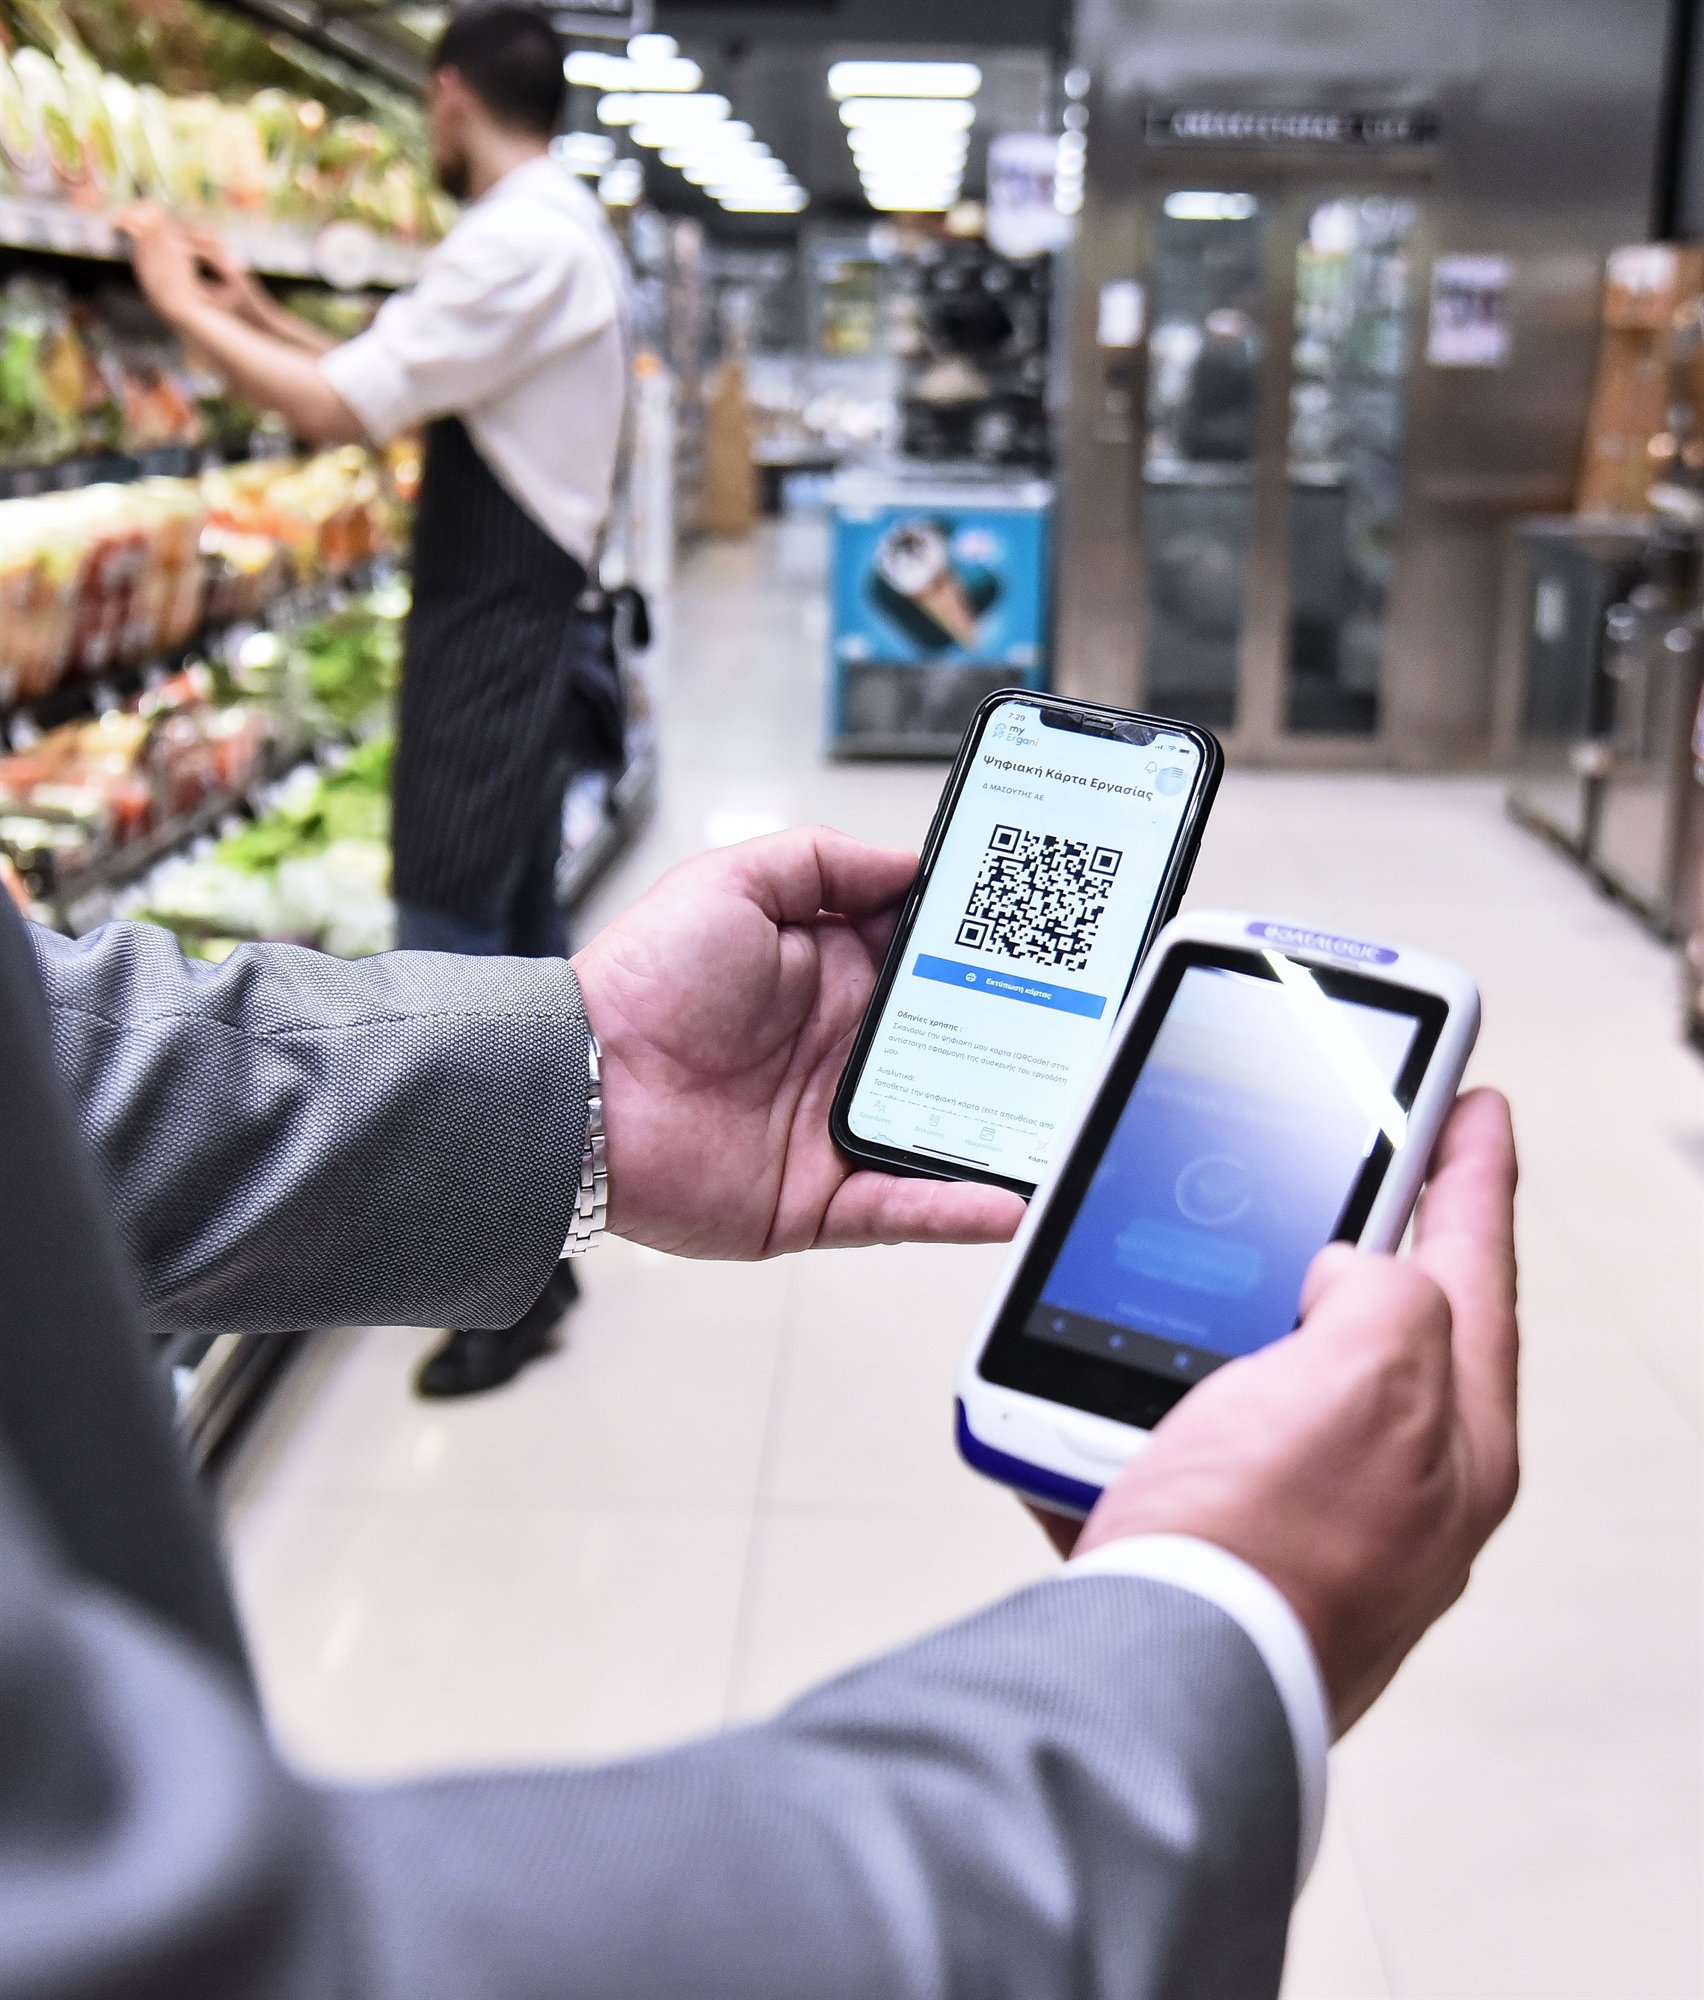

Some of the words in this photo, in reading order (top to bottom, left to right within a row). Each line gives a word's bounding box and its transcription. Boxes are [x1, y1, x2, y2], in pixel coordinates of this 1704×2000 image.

[1008, 712, 1026, 722] 7:29
[1009, 725, 1026, 736] my
[1006, 733, 1039, 748] Ergani
[983, 754, 1043, 778] Ψηφιακή
[1045, 767, 1088, 786] Κάρτα
[1090, 778, 1154, 802] Εργασίας
[989, 783, 1033, 799] ΜΑΣΟΥΤΗΣ
[1033, 793, 1044, 801] ΑΕ
[985, 977, 1024, 994] Εκτύπωση
[1024, 987, 1052, 1000] κάρτας
[897, 1010, 928, 1025] Οδηγίες
[929, 1019, 958, 1032] χρήσης
[884, 1047, 899, 1056] μου.
[892, 1022, 926, 1036] Σκανάρω
[927, 1031, 940, 1040] την
[941, 1035, 973, 1048] ψηφιακή
[973, 1043, 988, 1052] μου
[989, 1046, 1012, 1058] κάρτα
[1013, 1052, 1050, 1067] (QRCode)
[1050, 1061, 1070, 1072] στην
[888, 1035, 927, 1050] αντίστοιχη
[928, 1045, 965, 1060] εφαρμογή
[967, 1054, 979, 1063] της
[980, 1058, 1016, 1072] συσκευής
[1018, 1067, 1031, 1075] του
[1031, 1070, 1067, 1085] εργοδότη
[877, 1066, 916, 1082] Αναλυτικά:
[874, 1079, 909, 1093] Τοποθετώ
[911, 1089, 923, 1097] την
[924, 1092, 956, 1106] ψηφιακή
[957, 1100, 980, 1111] κάρτα
[981, 1105, 999, 1116] (είτε
[999, 1110, 1038, 1126] απευθείας
[1039, 1121, 1055, 1131] από
[1027, 1154, 1048, 1165] Κάρτα
